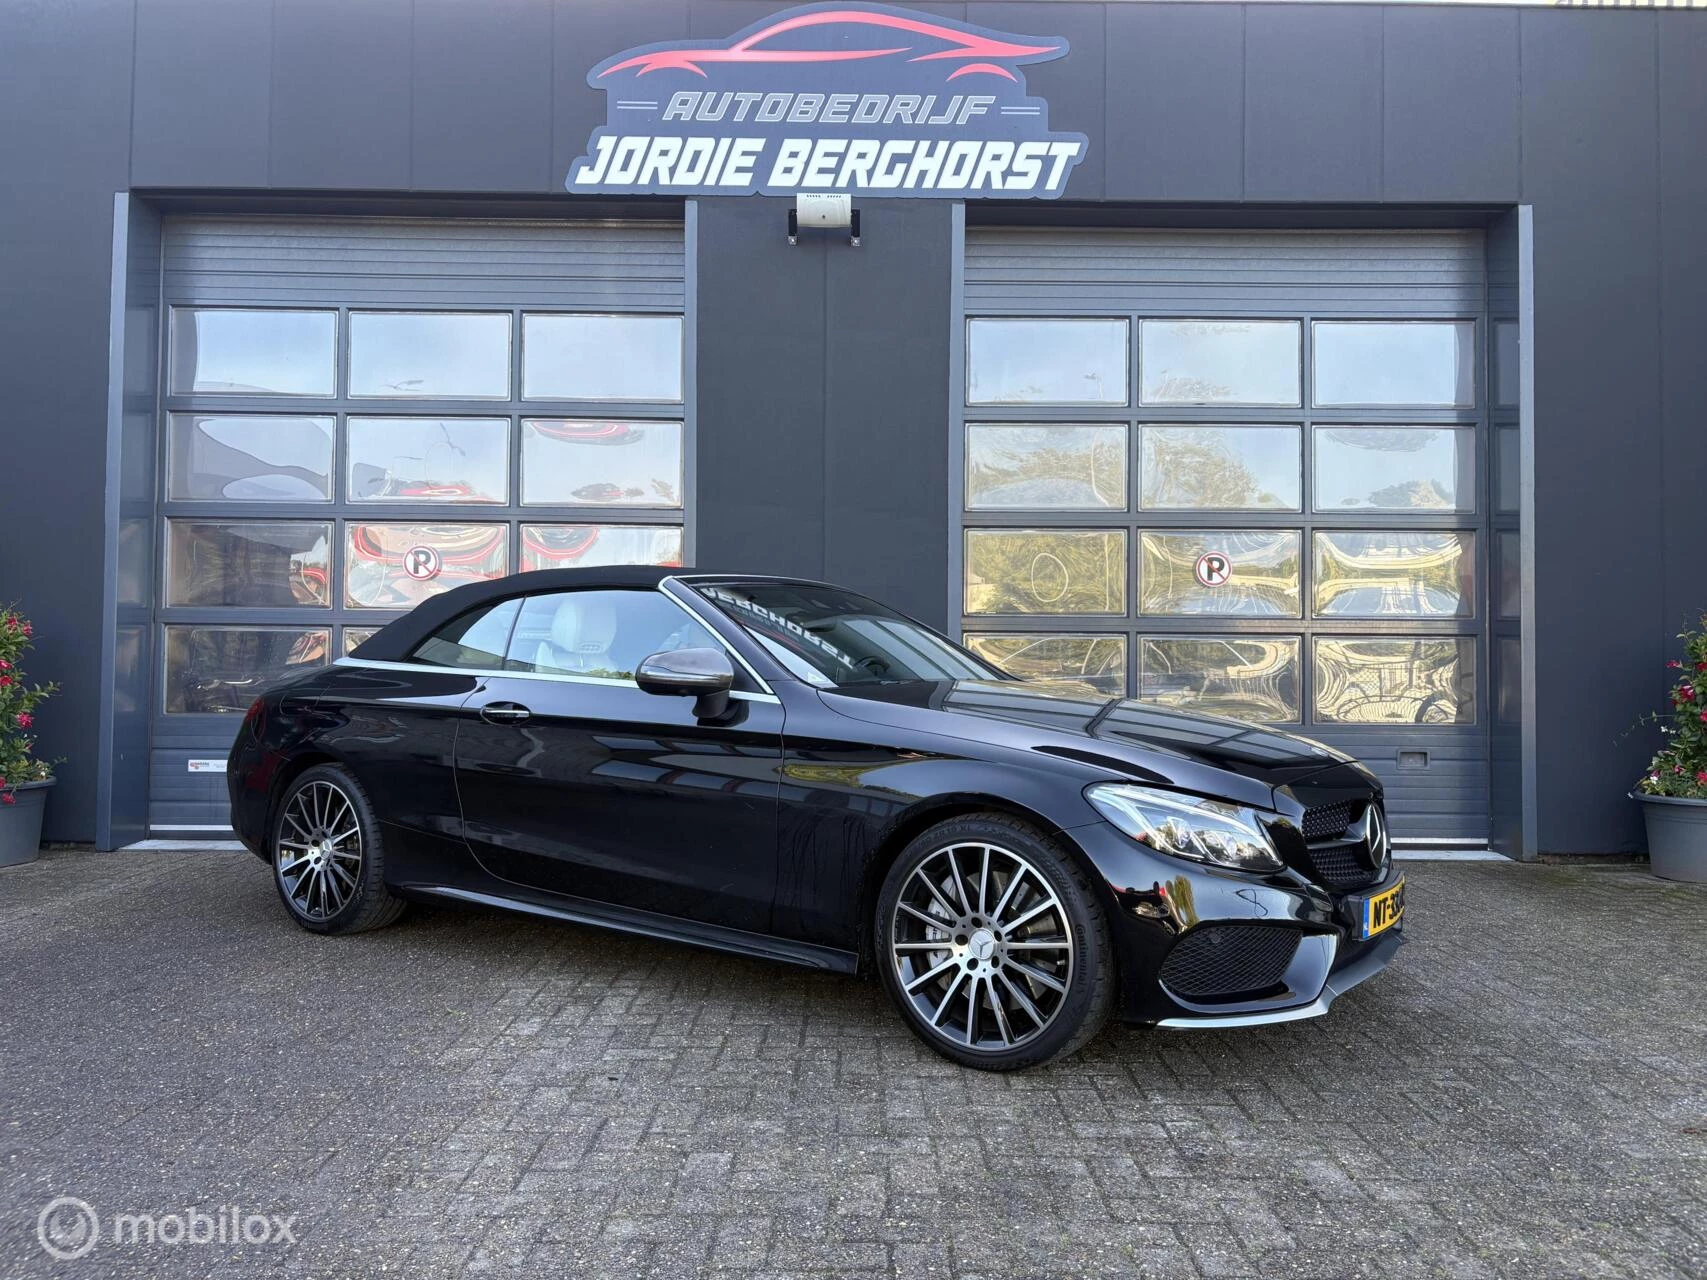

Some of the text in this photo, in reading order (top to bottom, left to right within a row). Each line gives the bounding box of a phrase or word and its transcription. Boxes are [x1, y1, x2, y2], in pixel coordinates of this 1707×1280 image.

[662, 91, 996, 125] AUTOBEDRIJF
[575, 135, 1081, 190] JORDIE BERGHORST
[413, 550, 431, 574] P
[1207, 557, 1225, 581] P
